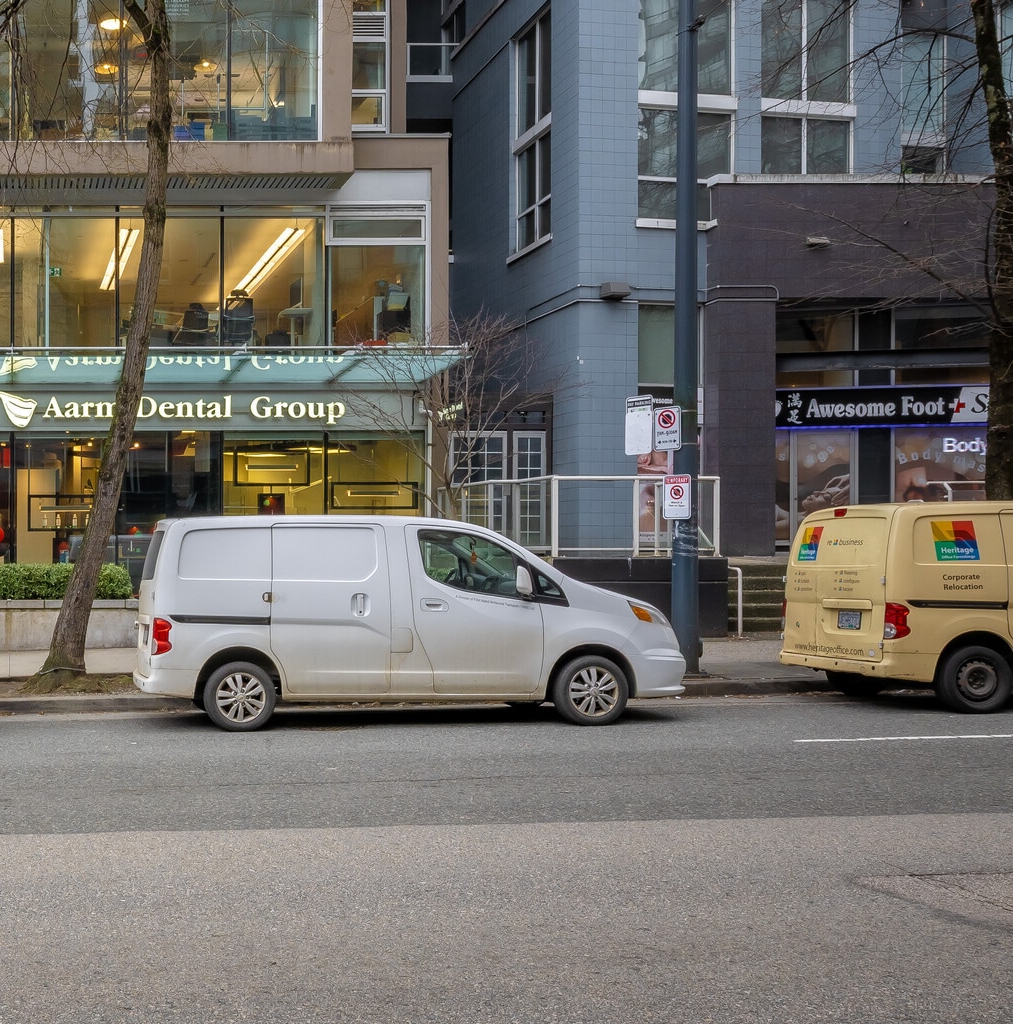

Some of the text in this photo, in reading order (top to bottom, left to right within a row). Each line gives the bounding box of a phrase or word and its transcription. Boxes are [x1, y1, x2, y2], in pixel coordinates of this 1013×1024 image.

[42, 394, 346, 425] Aarm Dental Group
[806, 398, 896, 418] Awesome
[901, 395, 945, 416] Foot
[942, 437, 987, 455] Body
[897, 448, 943, 464] Body
[795, 642, 864, 656] www.heritageoffice.com
